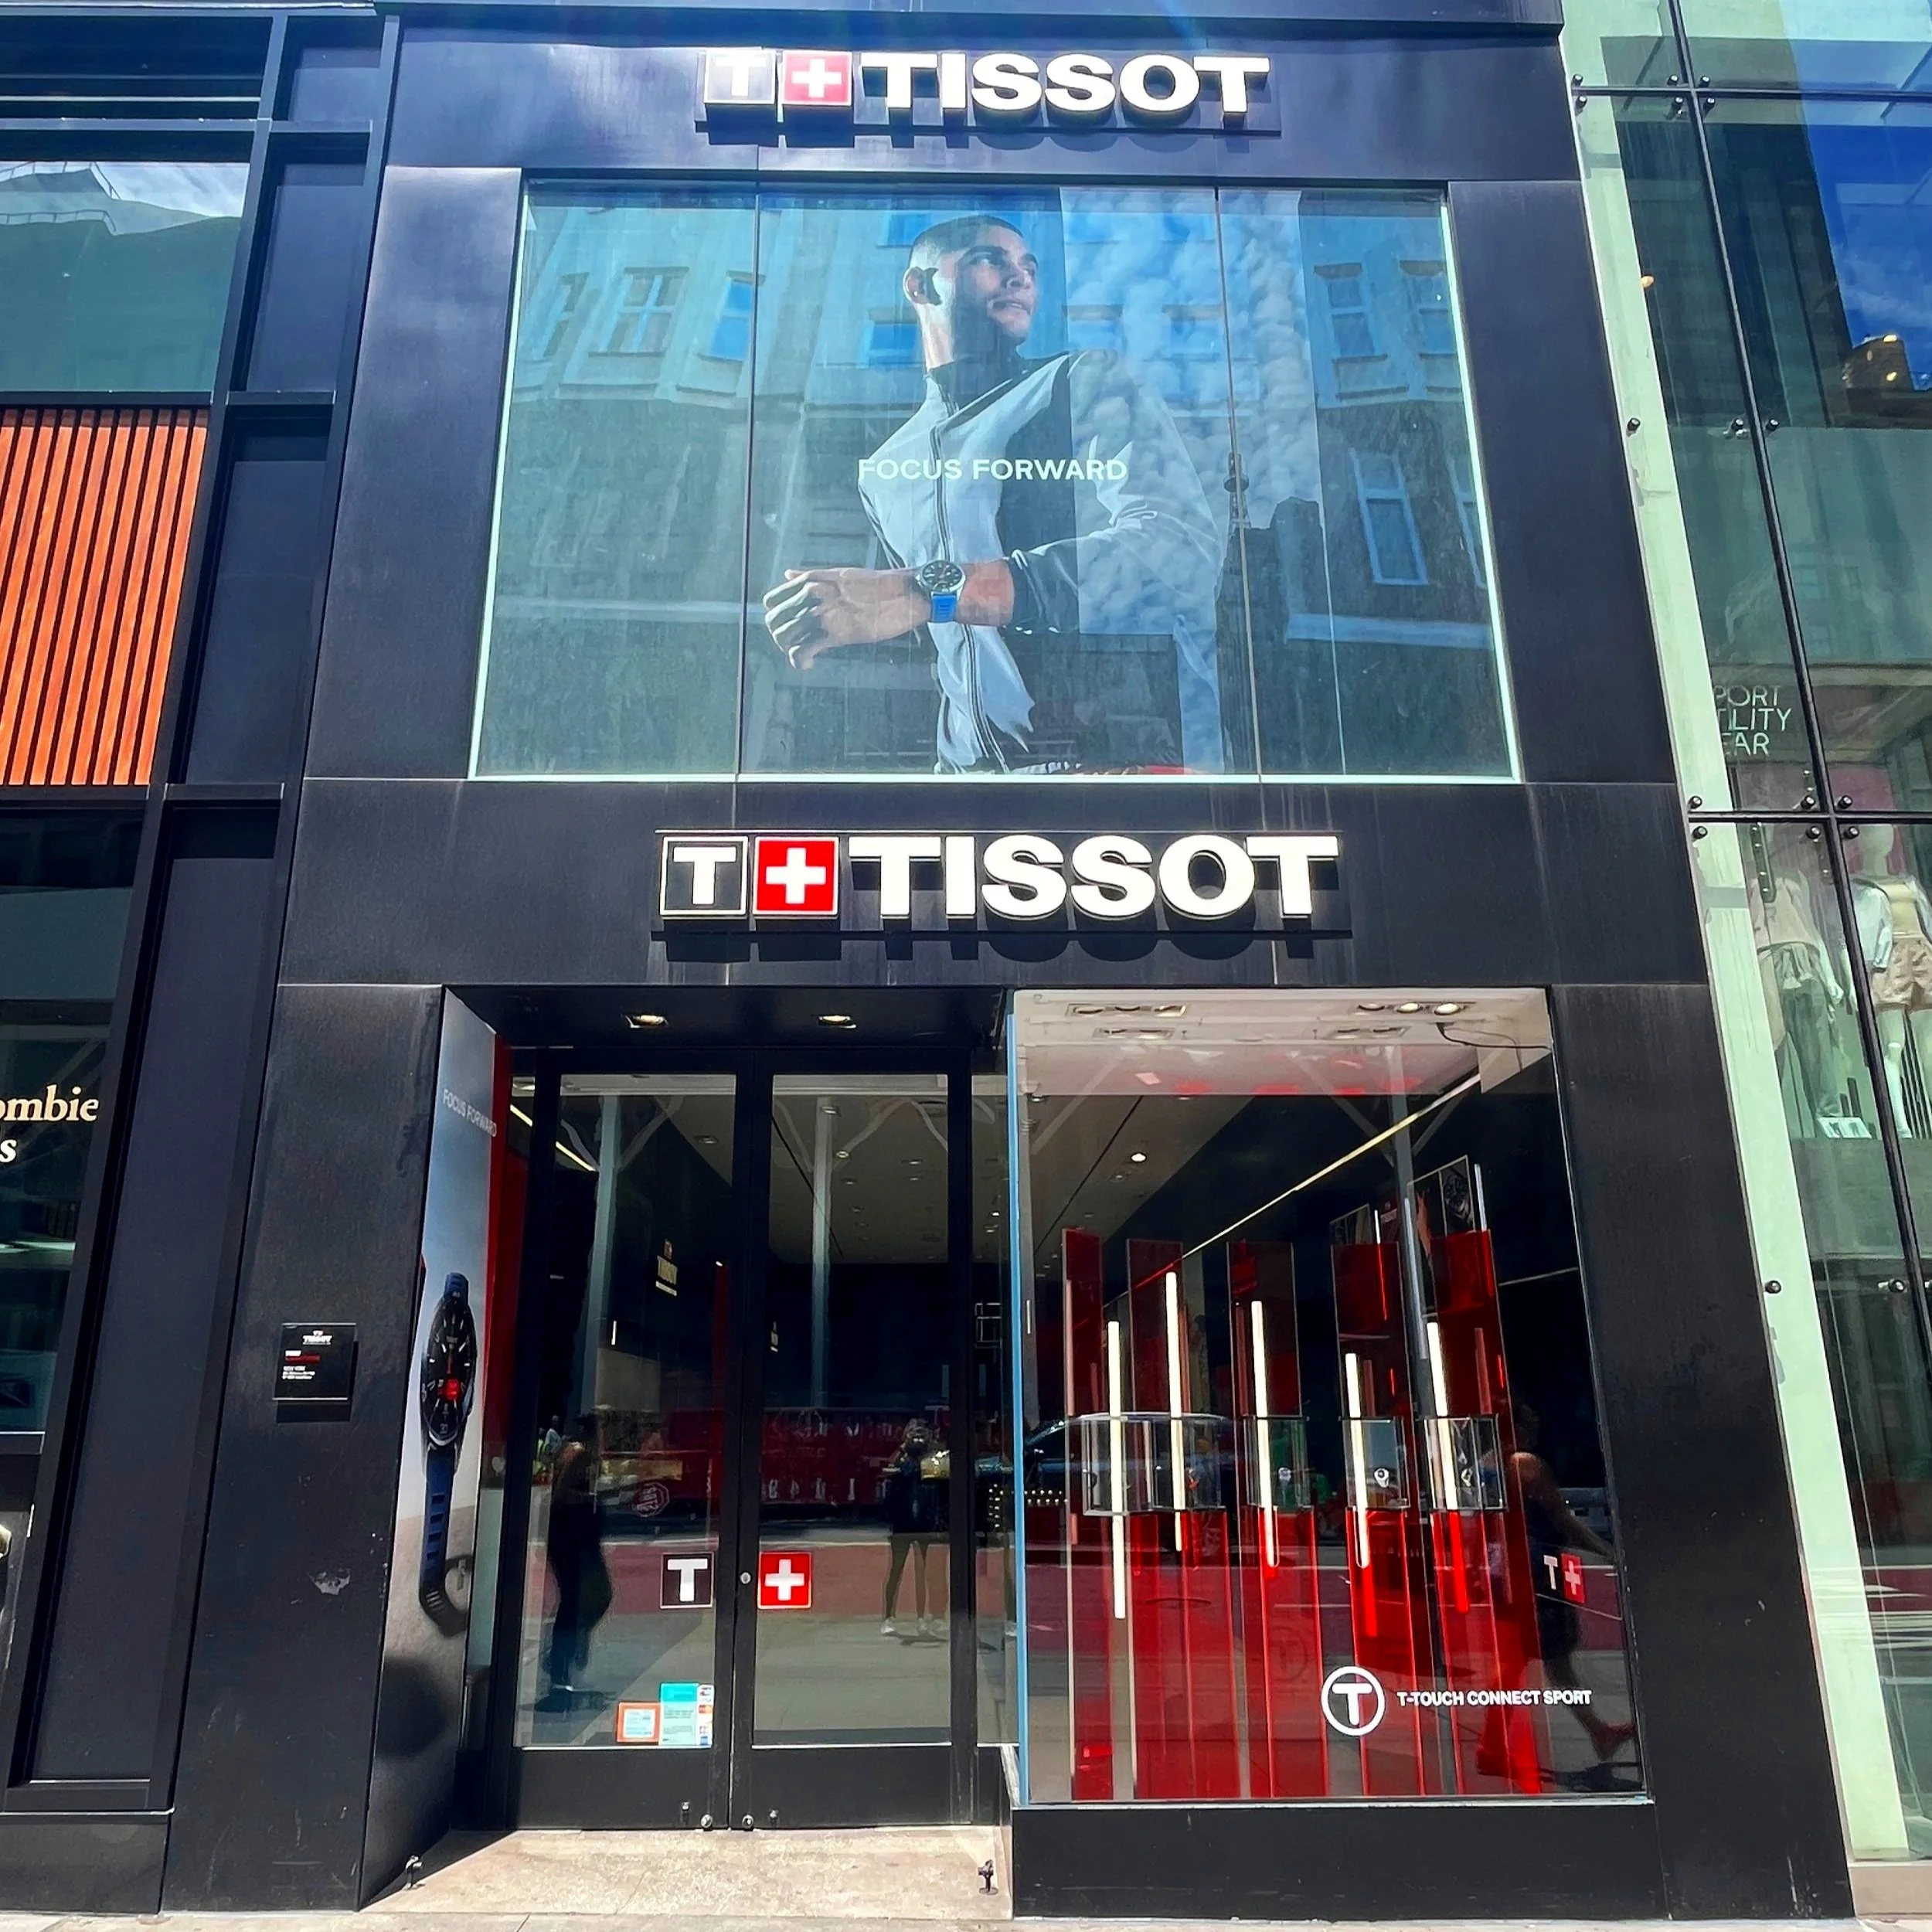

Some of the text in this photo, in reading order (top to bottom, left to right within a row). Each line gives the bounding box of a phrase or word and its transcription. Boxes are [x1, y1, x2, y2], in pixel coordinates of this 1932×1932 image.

[716, 53, 1270, 113] T TISSOT
[858, 458, 1128, 481] FOCUS FORWARD
[673, 834, 1340, 921] T TISSOT
[0, 1084, 99, 1121] mbie
[668, 1559, 708, 1602] T
[1396, 1691, 1464, 1706] T-TOUCH
[1467, 1690, 1542, 1706] CONNECT
[1543, 1689, 1592, 1705] SPORT
